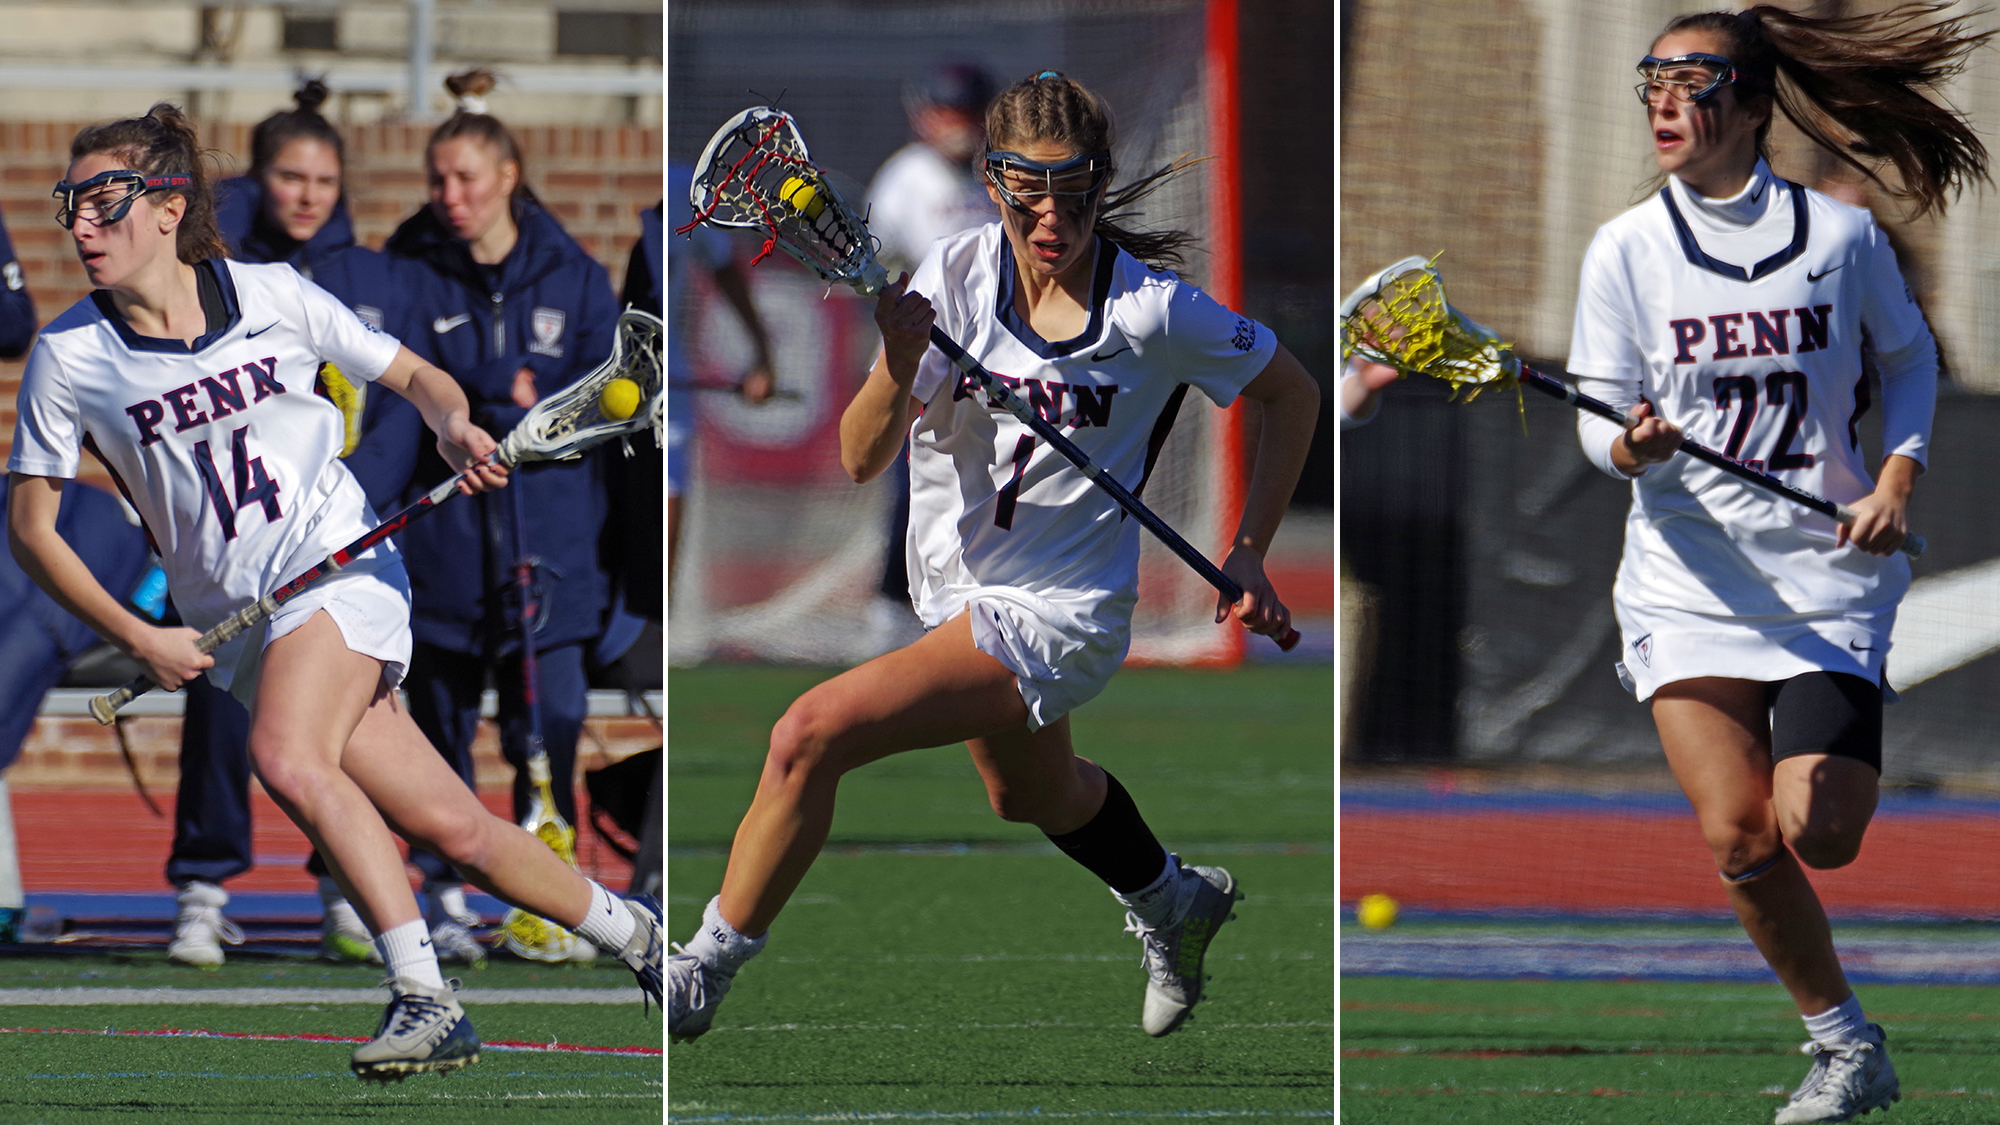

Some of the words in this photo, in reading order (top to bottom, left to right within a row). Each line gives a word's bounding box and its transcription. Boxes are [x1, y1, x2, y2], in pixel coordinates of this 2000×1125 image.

[1669, 304, 1833, 365] PENN
[125, 356, 287, 447] PENN
[1713, 371, 1815, 472] 22
[194, 424, 283, 543] 14
[994, 433, 1036, 531] 1
[711, 926, 727, 943] 16
